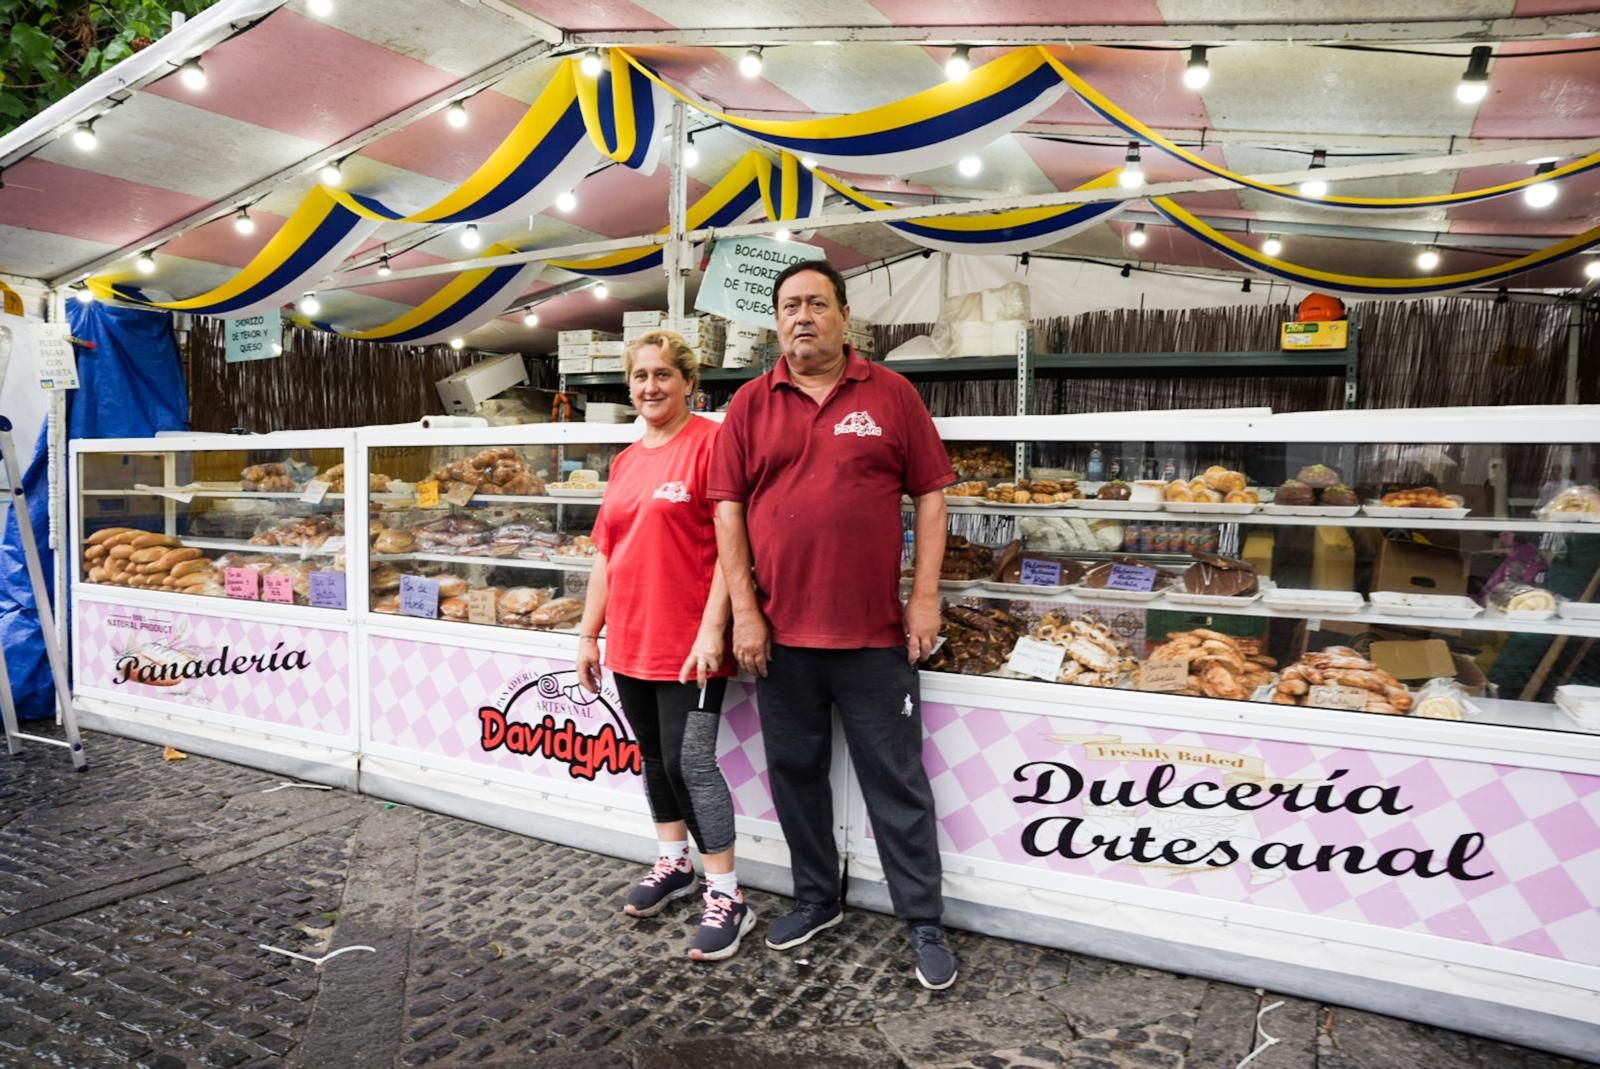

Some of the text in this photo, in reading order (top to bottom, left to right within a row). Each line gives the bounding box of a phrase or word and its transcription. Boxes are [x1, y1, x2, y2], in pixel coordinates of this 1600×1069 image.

[724, 277, 739, 290] DE
[240, 342, 263, 353] QUESO
[46, 359, 63, 367] CON
[40, 369, 73, 377] TARJETA
[107, 619, 173, 634] NATURAL PRODUCT
[113, 641, 311, 685] Panadería
[536, 701, 594, 719] ARTESANAL
[1097, 746, 1245, 769] Freshly Baked
[1012, 761, 1413, 816] Dulcería
[1020, 816, 1495, 881] Artesanal
